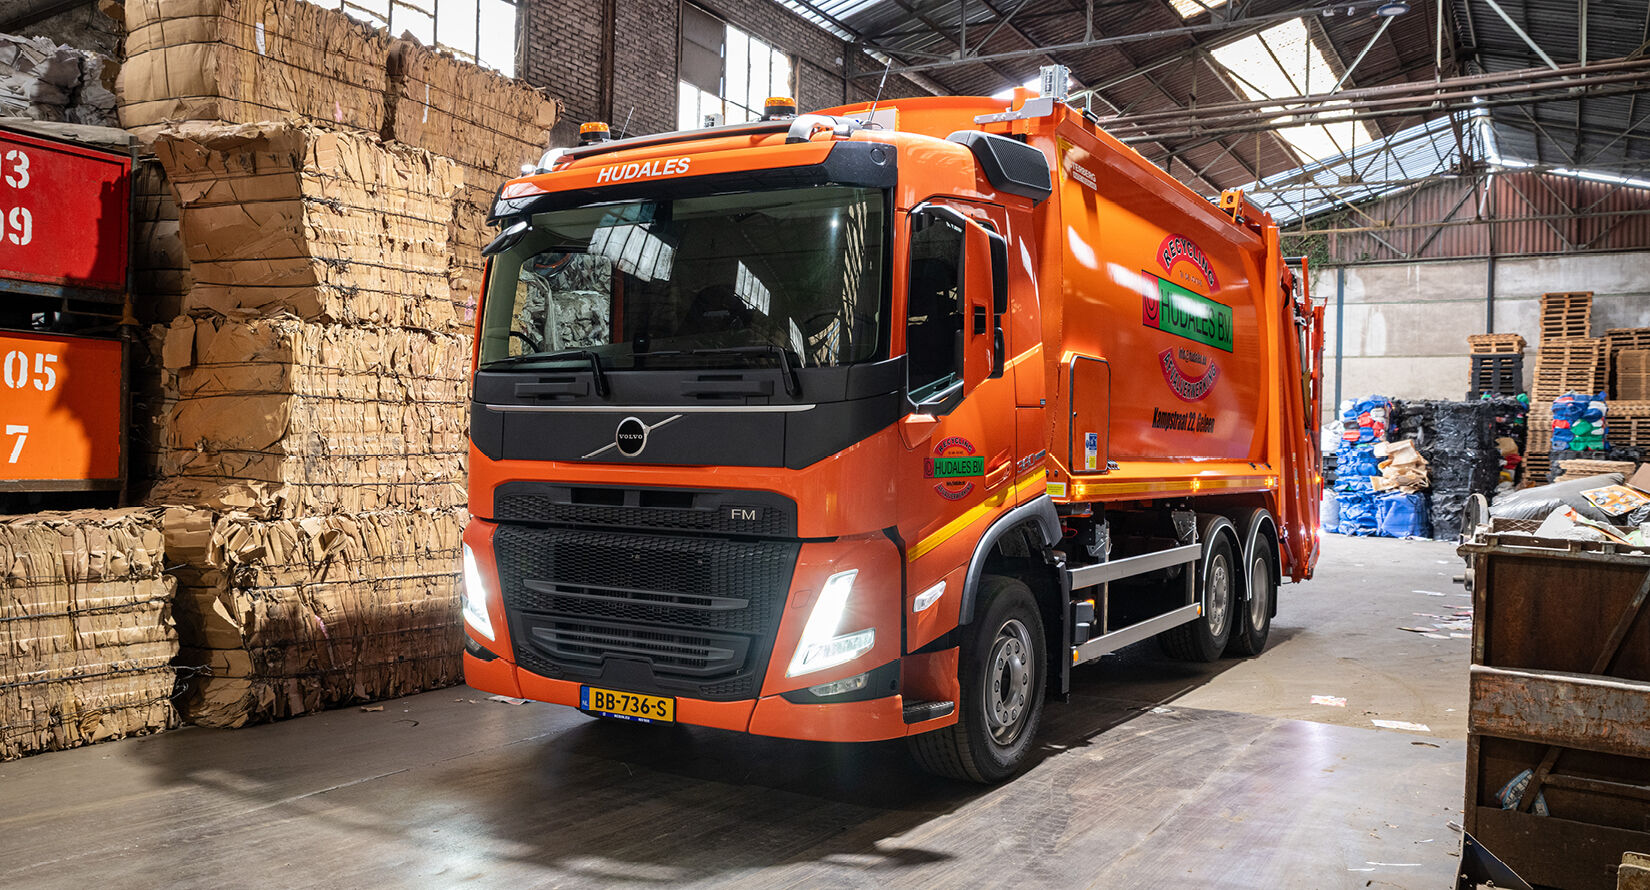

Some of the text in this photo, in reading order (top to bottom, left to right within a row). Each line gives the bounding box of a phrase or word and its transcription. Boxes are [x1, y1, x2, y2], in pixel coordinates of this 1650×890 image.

[0, 150, 30, 189] 3
[597, 157, 691, 183] HUDALES
[0, 206, 33, 246] 9
[1162, 237, 1215, 287] RECYCLING
[4, 350, 58, 391] 05
[1152, 407, 1188, 431] Kampstraat
[5, 424, 29, 464] 7
[938, 437, 973, 453] RECYCLING
[935, 460, 971, 475] HUDALES
[731, 508, 756, 520] FM
[595, 691, 667, 717] BB-736-S
